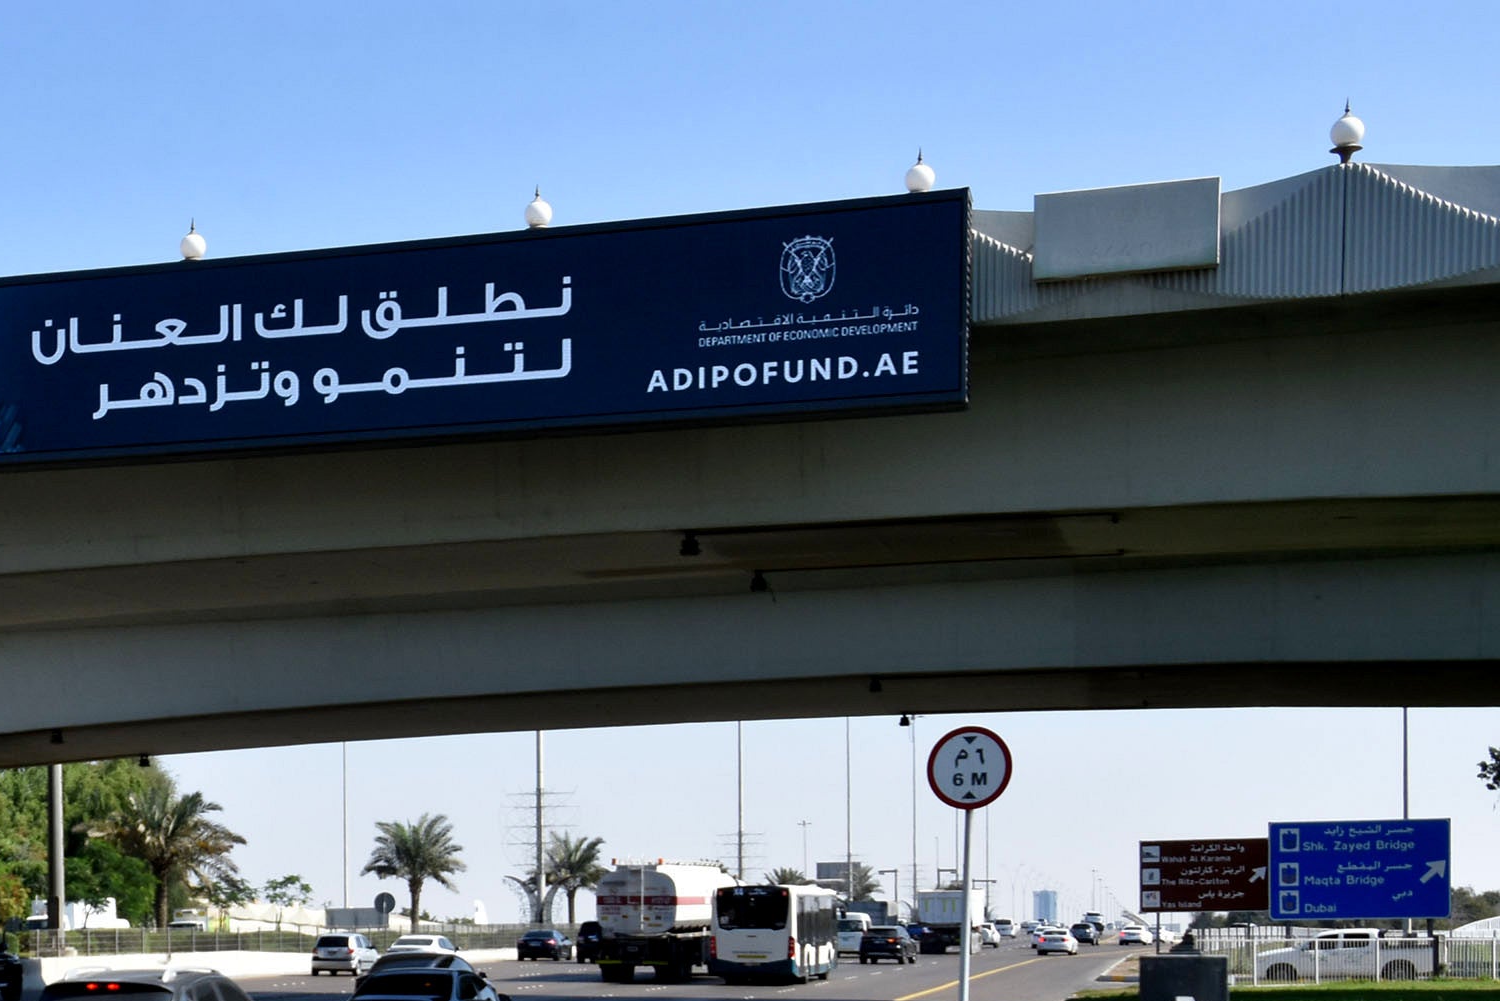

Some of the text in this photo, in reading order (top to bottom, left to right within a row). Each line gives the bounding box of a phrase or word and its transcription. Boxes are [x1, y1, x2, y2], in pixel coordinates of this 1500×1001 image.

[31, 275, 572, 365] نطلق لك العنان
[698, 304, 919, 333] دائرة التنمية الاقتصادية
[698, 321, 919, 348] DEPARTMENT OF ECONOMIC DEVELOPMENT
[92, 338, 572, 420] لتنمو وتزدهر
[646, 351, 919, 393] ADIPOFUND.AE
[953, 772, 987, 786] 6 M
[1349, 825, 1382, 837] الشيخ
[1302, 840, 1415, 853] Shk. Zayed Bridge
[1303, 875, 1385, 887] Maqta Bridge
[1304, 903, 1337, 913] Dubai
